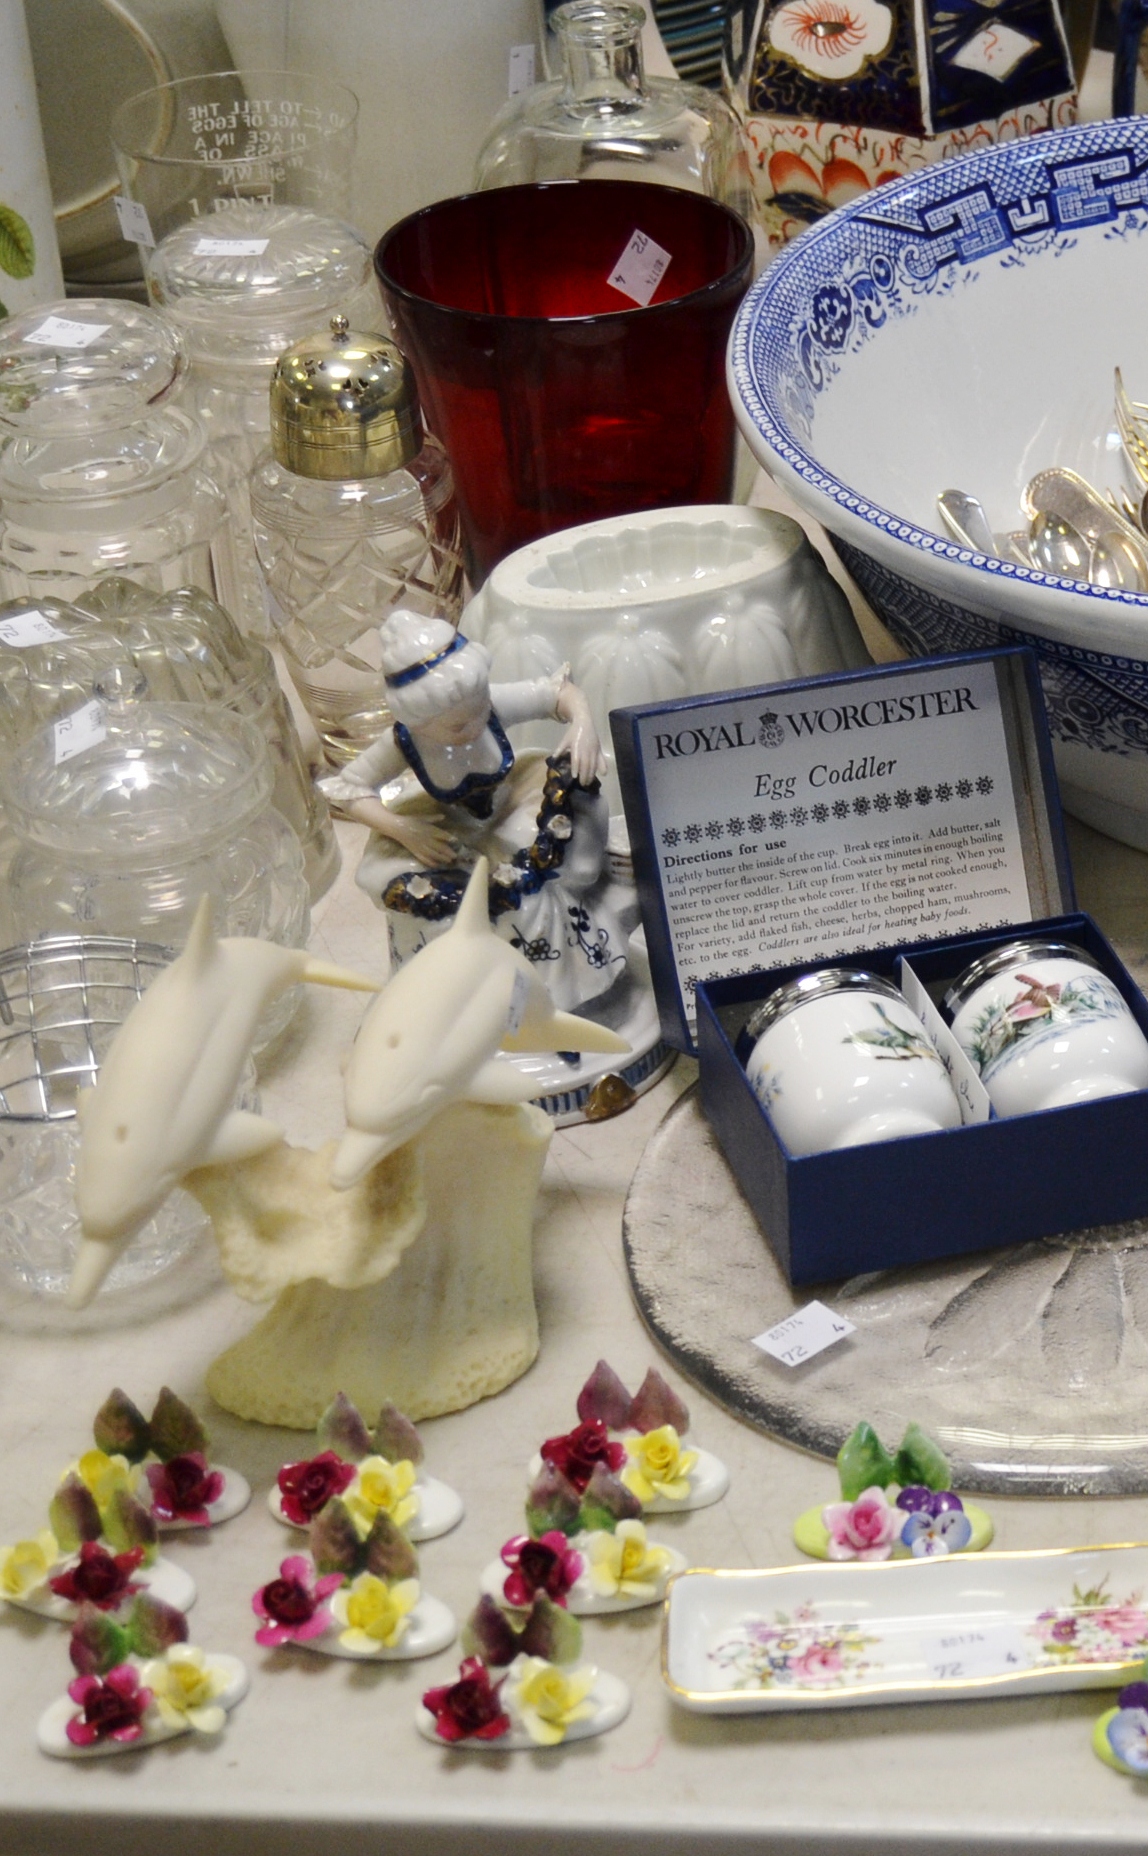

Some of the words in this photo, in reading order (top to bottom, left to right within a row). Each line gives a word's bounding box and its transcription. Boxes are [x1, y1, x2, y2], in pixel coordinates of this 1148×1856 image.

[631, 234, 649, 255] 72
[614, 275, 627, 285] 4
[653, 721, 756, 760] ROYAL
[784, 687, 980, 738] WORCESTER
[752, 772, 797, 801] Egg
[808, 755, 898, 788] Coddler
[661, 848, 734, 869] Directions
[737, 842, 759, 856] for
[763, 839, 787, 851] use
[664, 868, 704, 885] Lightly
[703, 865, 736, 878] butter
[736, 860, 754, 873] the
[754, 854, 786, 870] inside
[785, 851, 798, 864] of
[797, 849, 815, 862] the
[815, 848, 839, 859] cup.
[842, 839, 872, 854] Break
[871, 838, 891, 851] egg
[890, 834, 912, 846] into
[911, 830, 923, 842] it.
[926, 825, 949, 840] Add
[948, 822, 983, 835] butter,
[982, 816, 1001, 829] salt
[667, 884, 687, 898] and
[687, 881, 723, 897] pepper
[722, 877, 739, 889] for
[738, 872, 778, 886] flavour.
[777, 866, 809, 879] Screw
[809, 864, 824, 874] on
[822, 858, 841, 871] lid.
[840, 853, 868, 868] Cook
[867, 851, 883, 863] six
[882, 846, 923, 861] minutes
[921, 843, 934, 854] in
[933, 836, 970, 852] enough
[968, 832, 1004, 846] boiling
[669, 899, 698, 912] water
[699, 897, 712, 907] to
[712, 892, 741, 904] cover
[742, 884, 784, 899] coddler.
[786, 878, 808, 892] Lift
[808, 876, 829, 888] cup
[829, 872, 855, 884] from
[855, 867, 884, 879] water
[884, 863, 899, 876] by
[900, 856, 928, 871] metal
[929, 855, 953, 866] ring.
[955, 849, 985, 861] When
[986, 845, 1006, 859] you
[671, 911, 714, 926] unscrew
[713, 906, 731, 918] the
[730, 904, 752, 916] top,
[751, 899, 780, 914] grasp
[779, 894, 797, 907] the
[797, 888, 828, 903] whole
[827, 885, 859, 898] cover.
[860, 879, 871, 892] If
[871, 878, 888, 891] the
[888, 876, 907, 889] egg
[906, 873, 917, 884] is
[916, 870, 934, 882] not
[933, 863, 968, 880] cooked
[968, 857, 1008, 873] enough,
[673, 925, 710, 940] replace
[711, 920, 729, 933] the
[730, 916, 746, 929] lid
[746, 912, 767, 926] and
[768, 910, 801, 923] return
[801, 905, 820, 917] the
[820, 898, 858, 913] coddler
[859, 897, 871, 907] to
[872, 892, 889, 904] the
[889, 886, 926, 901] boiling
[926, 881, 957, 893] water.
[675, 941, 695, 953] For
[697, 935, 736, 949] variety,
[736, 928, 757, 942] add
[757, 922, 789, 938] flaked
[789, 919, 812, 933] fish,
[813, 915, 849, 928] cheese,
[850, 907, 882, 922] herbs,
[882, 898, 925, 916] chopped
[925, 896, 952, 908] ham,
[952, 886, 1011, 903] mushrooms,
[677, 956, 697, 967] etc.
[698, 953, 711, 963] to
[711, 948, 729, 961] the
[730, 946, 753, 959] egg.
[757, 936, 800, 952] Coddlers
[802, 934, 819, 944] are
[820, 929, 840, 941] also
[841, 922, 866, 937] ideal
[865, 921, 882, 936] for
[883, 915, 919, 930] heating
[918, 910, 942, 923] baby
[942, 905, 971, 922] foods.
[768, 1319, 804, 1341] 80174
[781, 1345, 809, 1362] 72
[832, 1323, 846, 1333] 4
[934, 1662, 964, 1679] 72
[1005, 1651, 1018, 1665] 4
